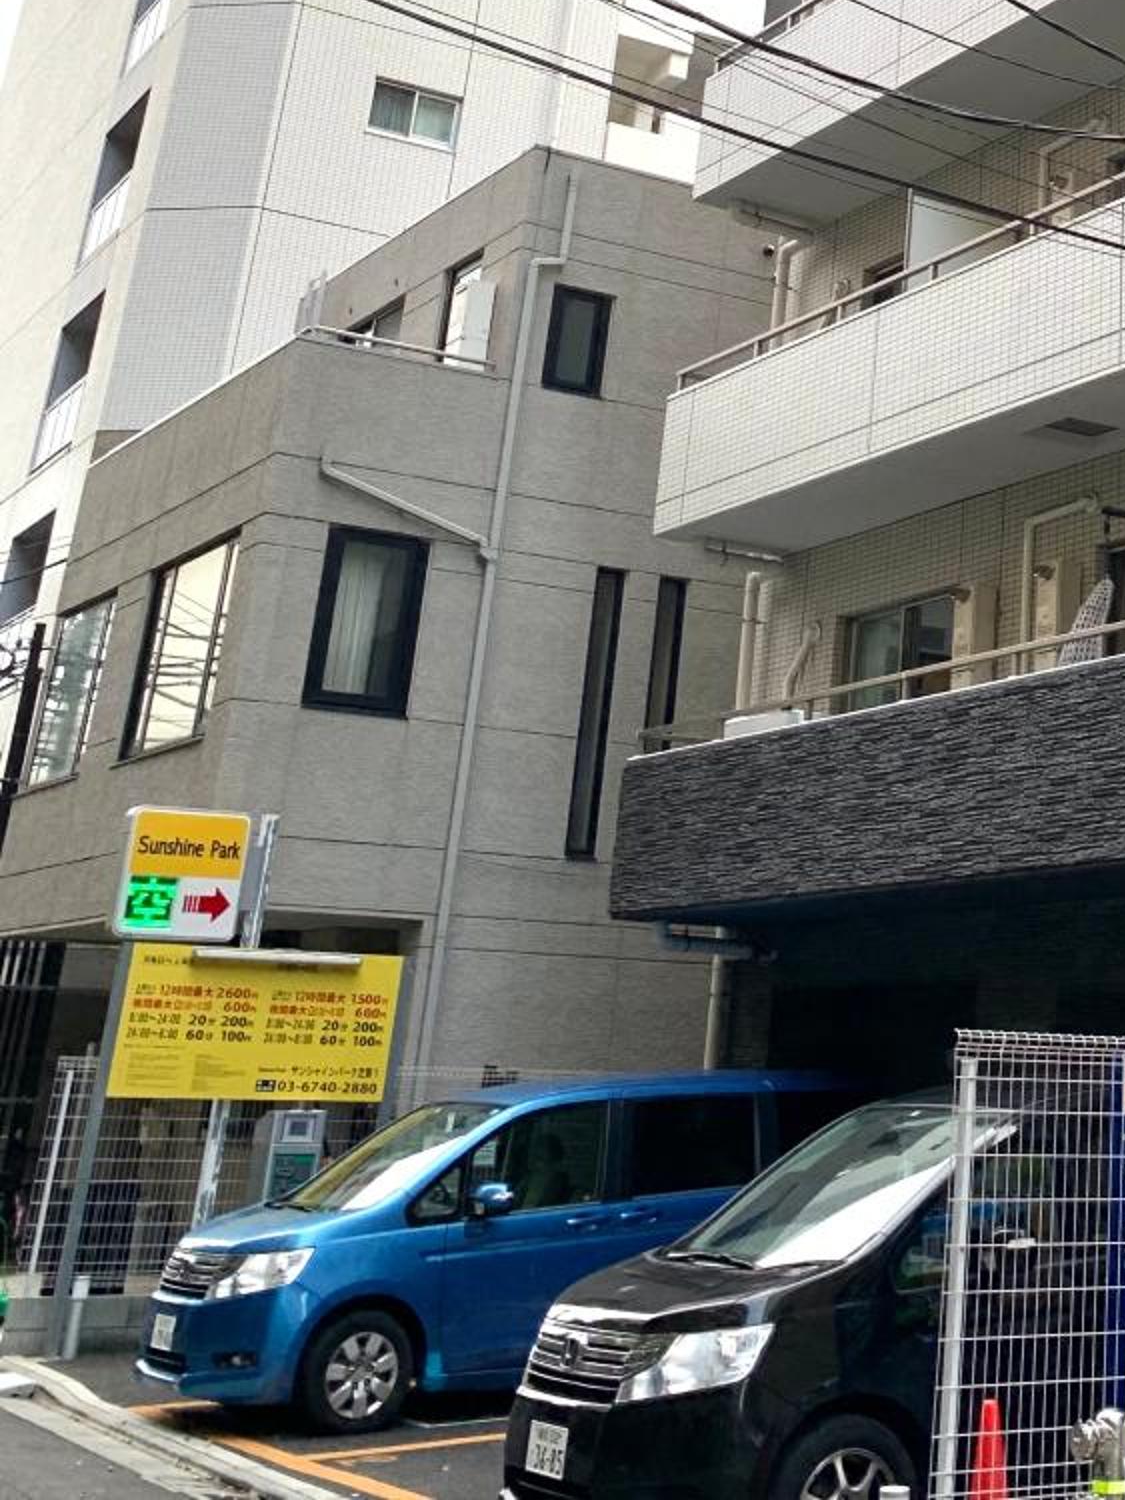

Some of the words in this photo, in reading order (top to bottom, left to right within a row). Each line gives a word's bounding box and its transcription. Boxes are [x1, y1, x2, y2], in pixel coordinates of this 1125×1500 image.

[137, 835, 204, 858] Sunshine
[210, 840, 241, 861] Park
[124, 877, 177, 929] 空
[277, 1080, 378, 1095] 03-6740-2880
